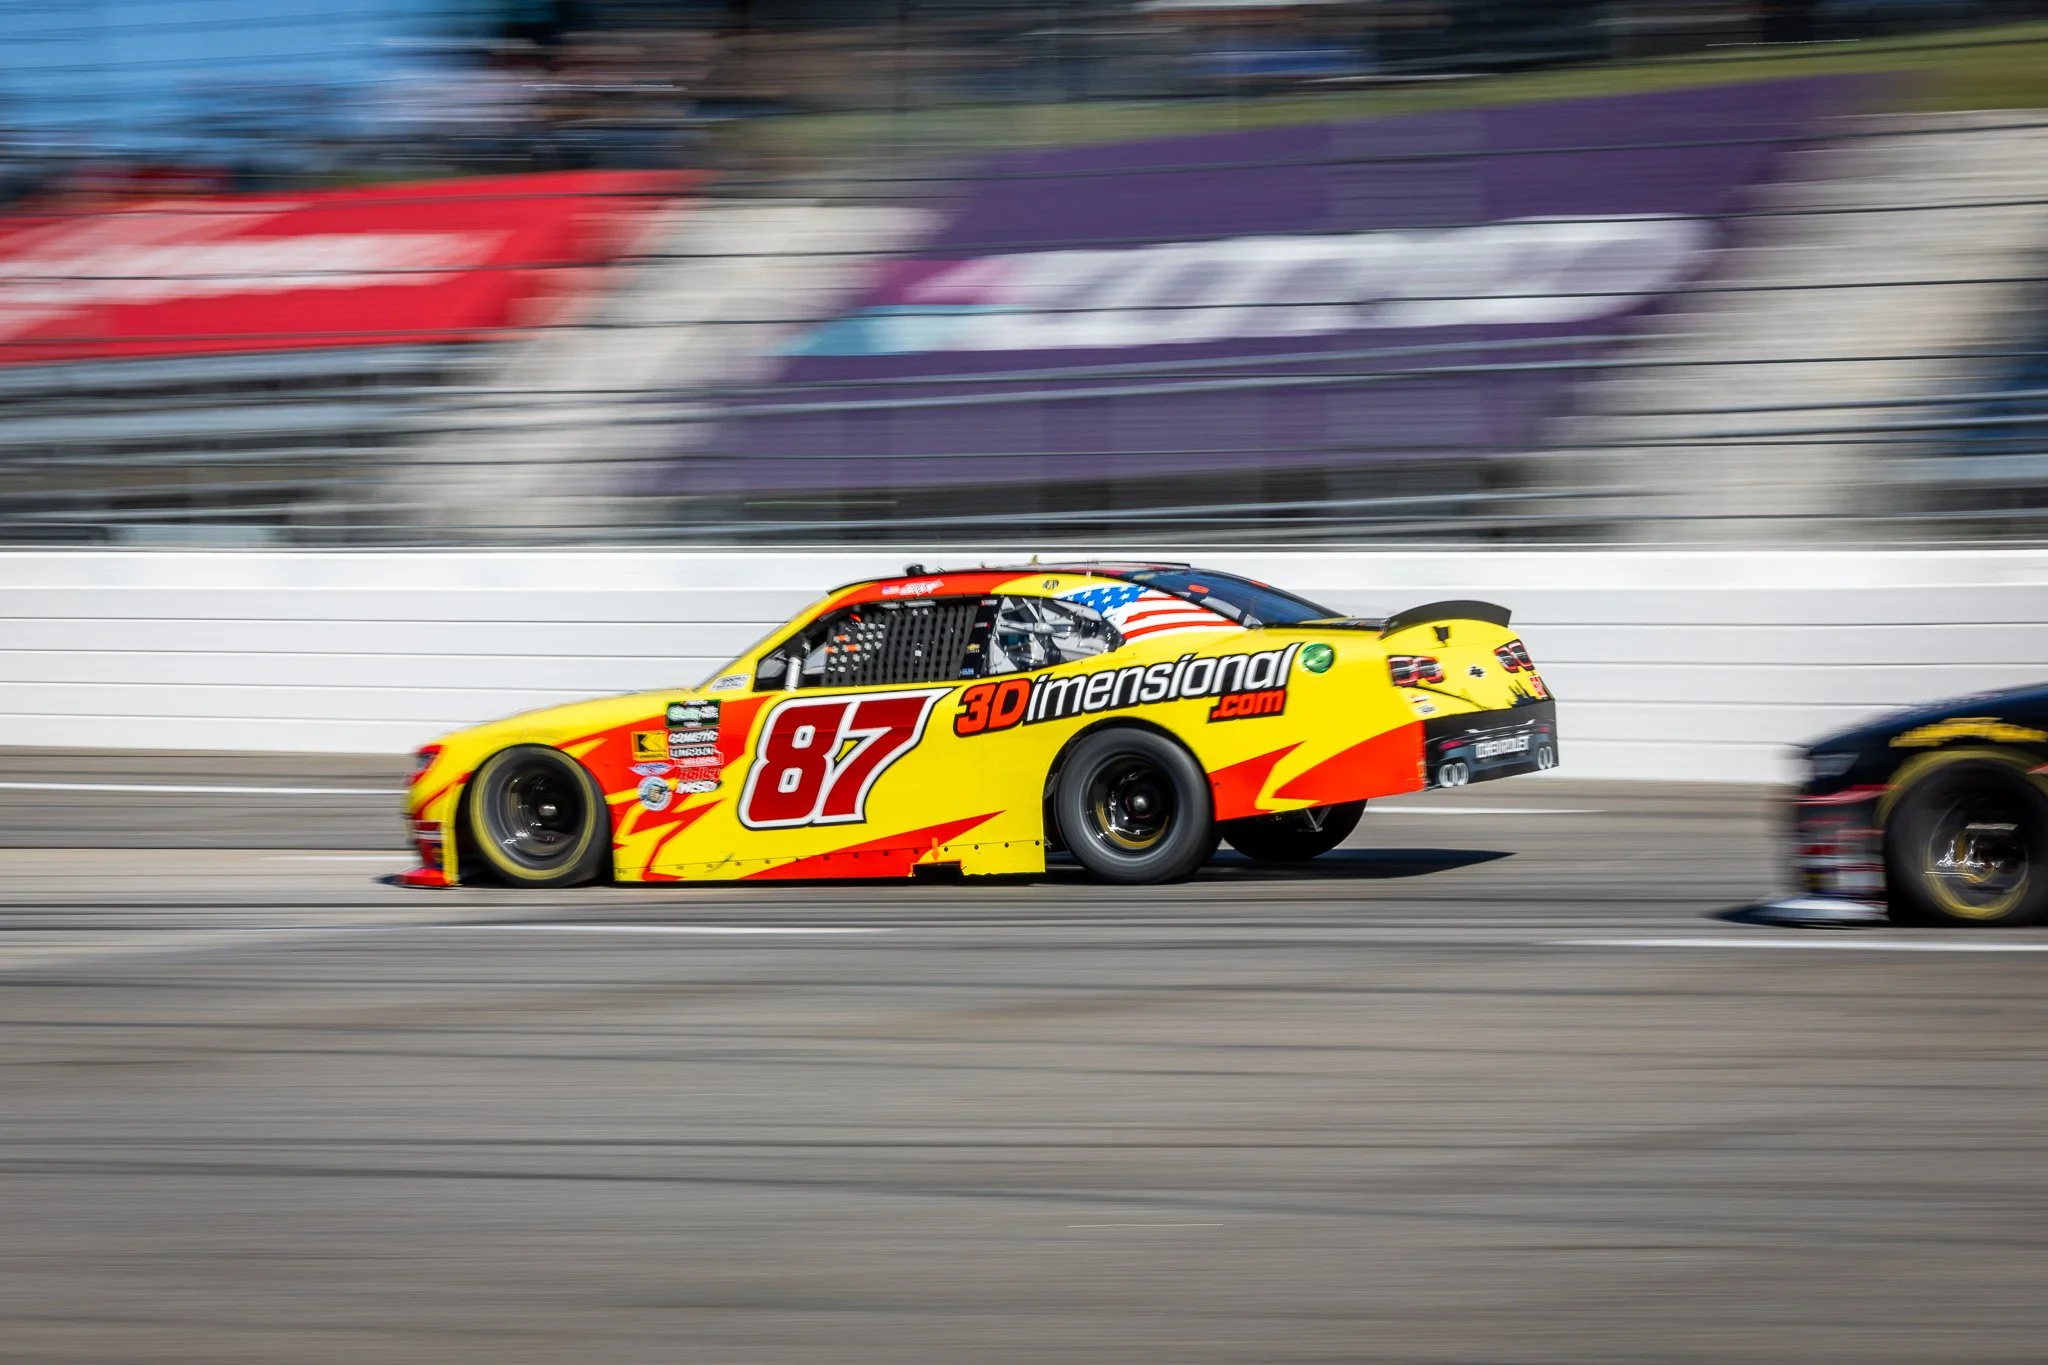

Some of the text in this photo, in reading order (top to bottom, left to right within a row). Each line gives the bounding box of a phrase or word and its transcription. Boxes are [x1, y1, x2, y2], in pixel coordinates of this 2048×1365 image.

[955, 643, 1303, 737] 3Dimensional
[1211, 690, 1286, 720] .com
[738, 688, 954, 829] 87
